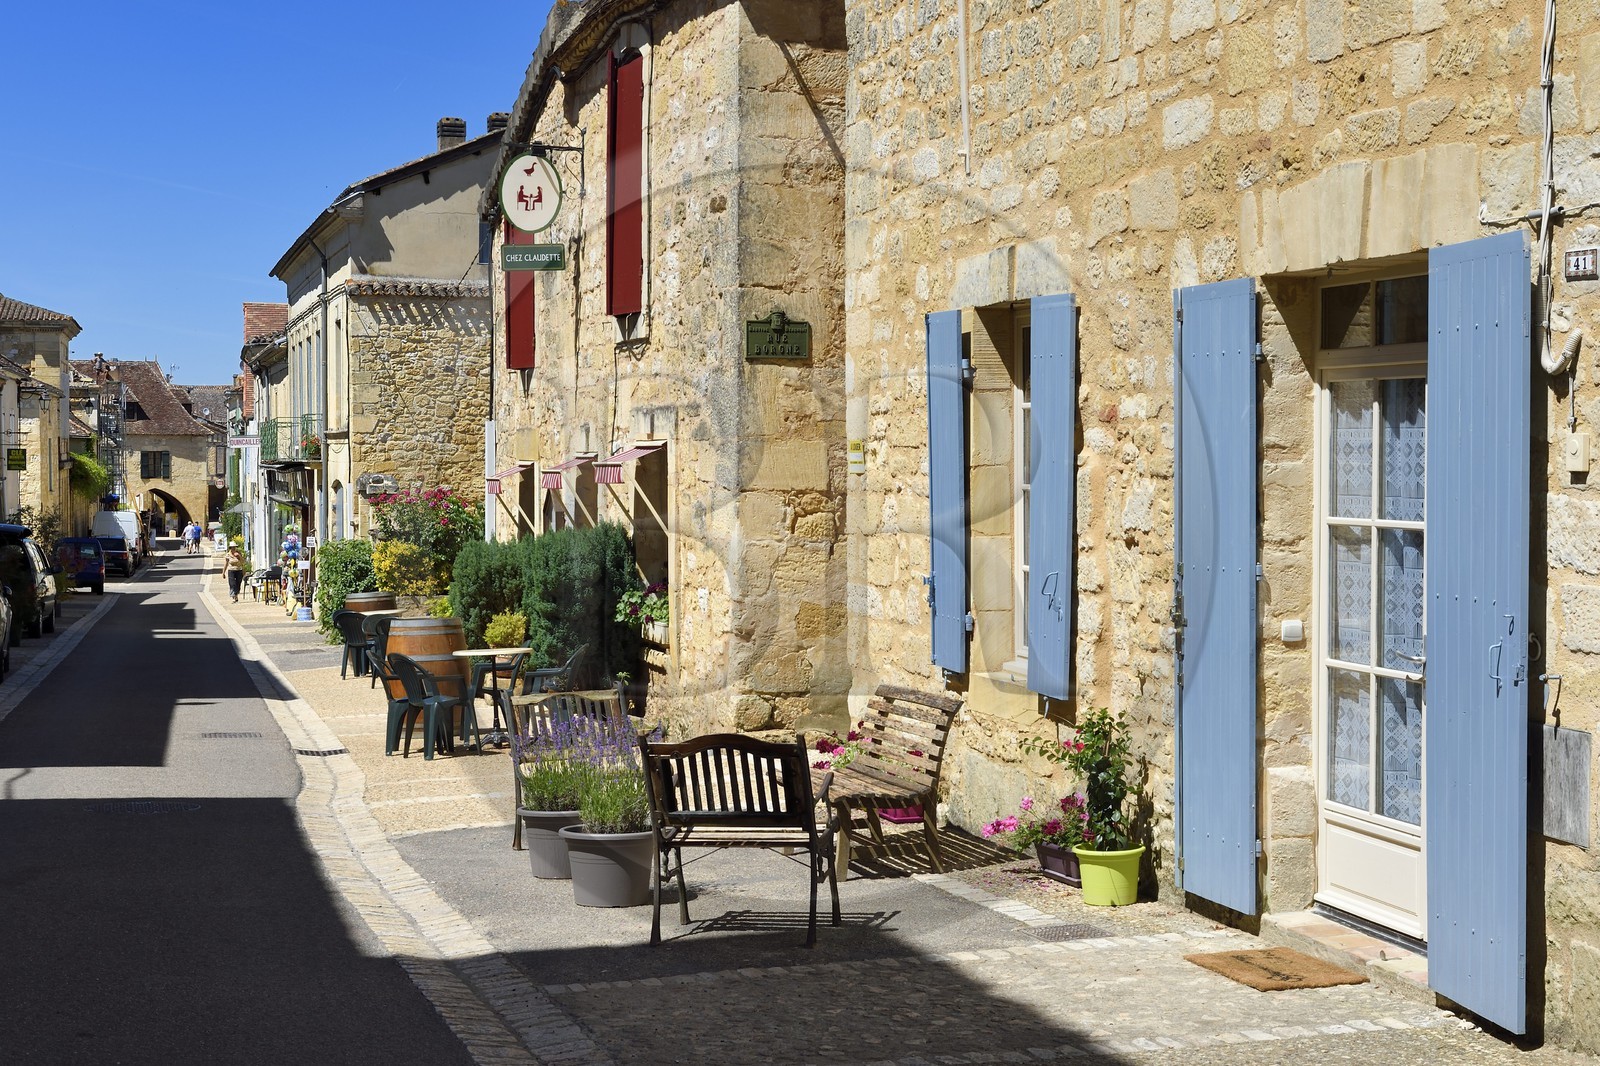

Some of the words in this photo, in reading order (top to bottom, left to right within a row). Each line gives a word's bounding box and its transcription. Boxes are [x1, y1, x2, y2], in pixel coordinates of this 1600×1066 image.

[505, 254, 523, 262] CHEZ
[524, 253, 561, 262] CLAUDETTE
[1573, 256, 1587, 270] 41
[767, 333, 789, 344] RUE
[755, 344, 801, 356] BORGNE
